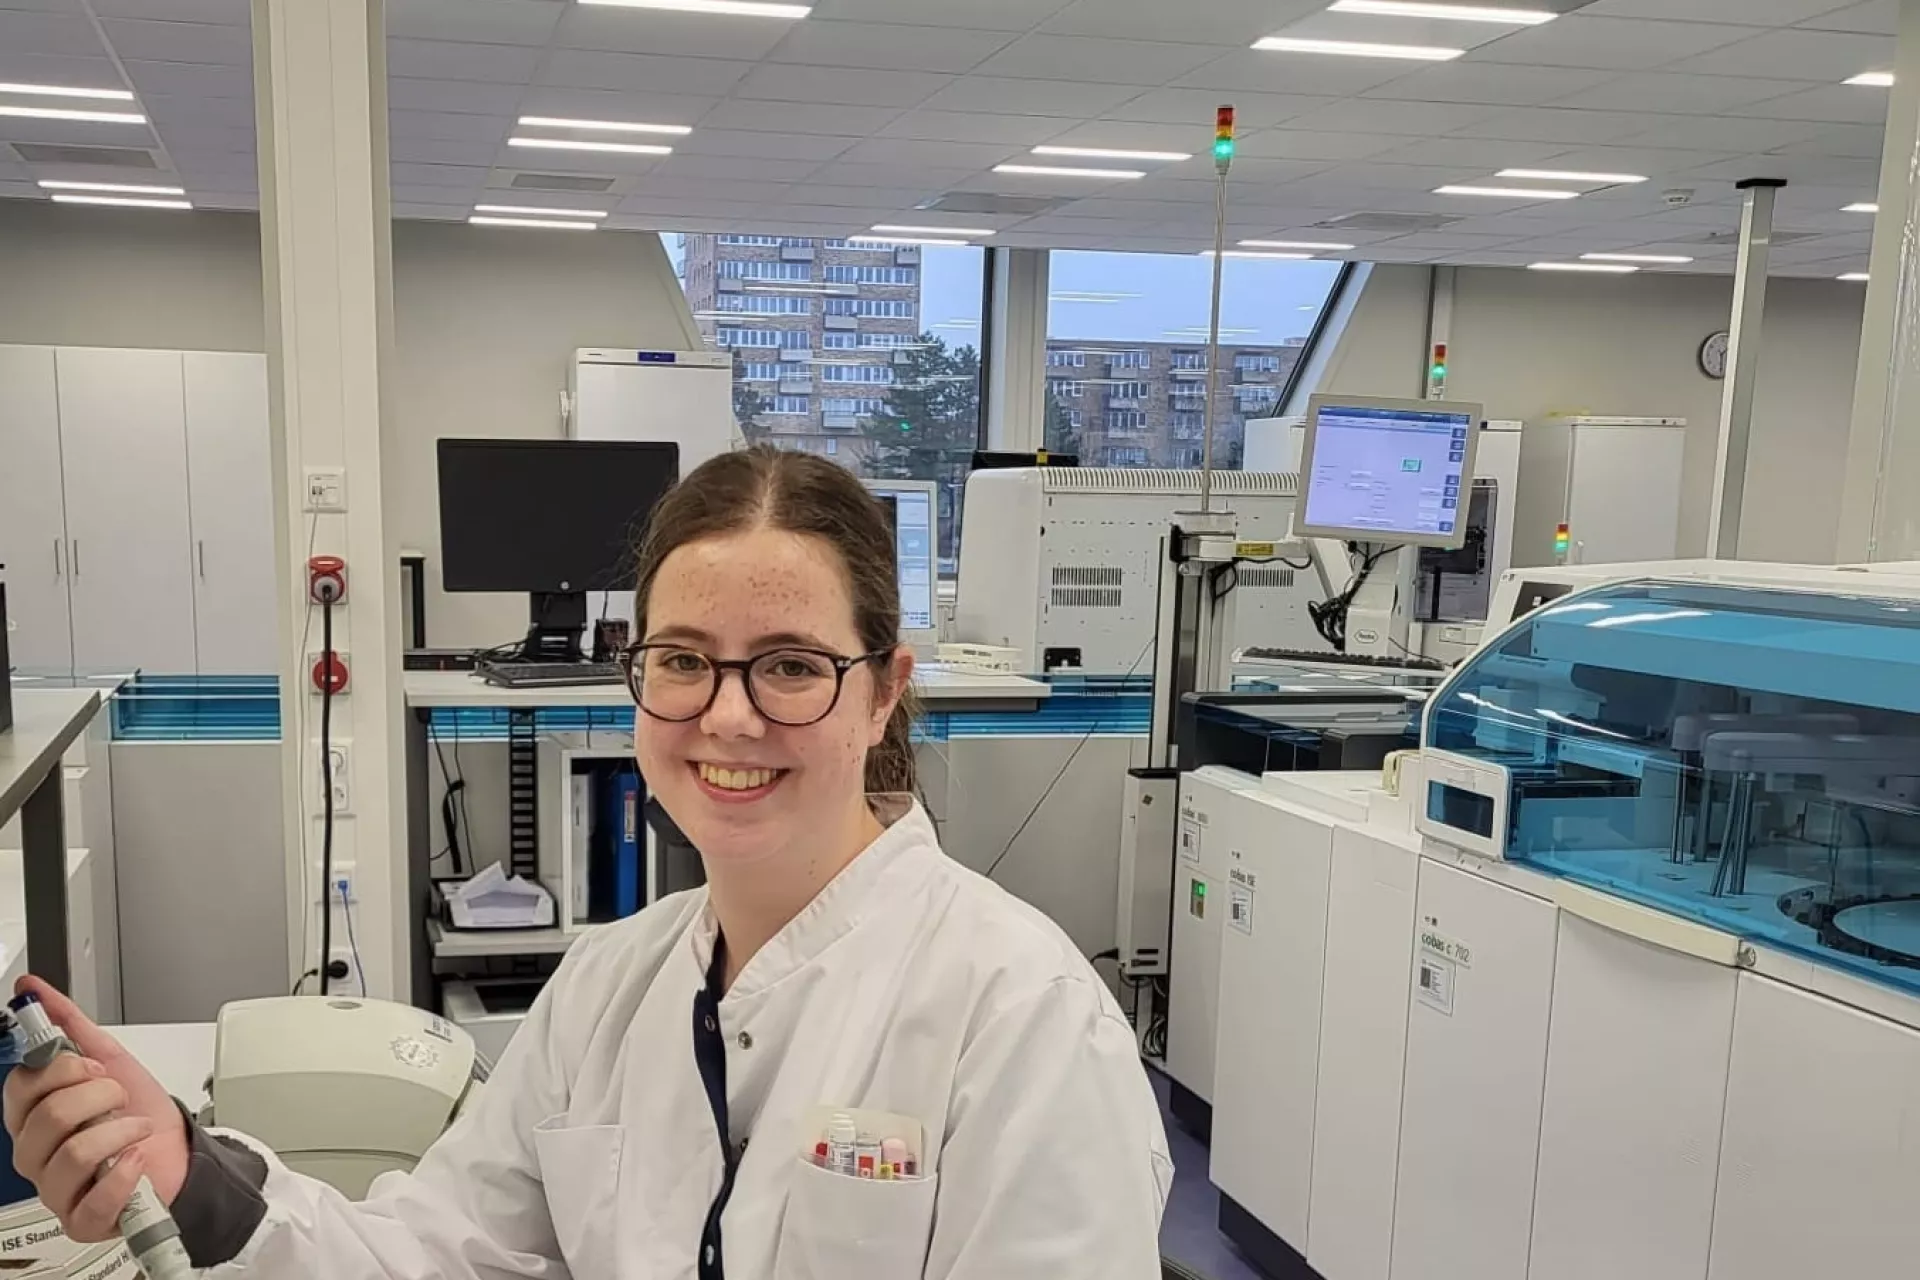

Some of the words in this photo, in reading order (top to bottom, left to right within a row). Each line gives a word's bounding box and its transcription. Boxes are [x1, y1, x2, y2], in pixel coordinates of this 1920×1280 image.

[1421, 932, 1444, 952] cobas
[1446, 943, 1452, 955] c
[1455, 943, 1470, 963] 702
[2, 1235, 23, 1252] ISE
